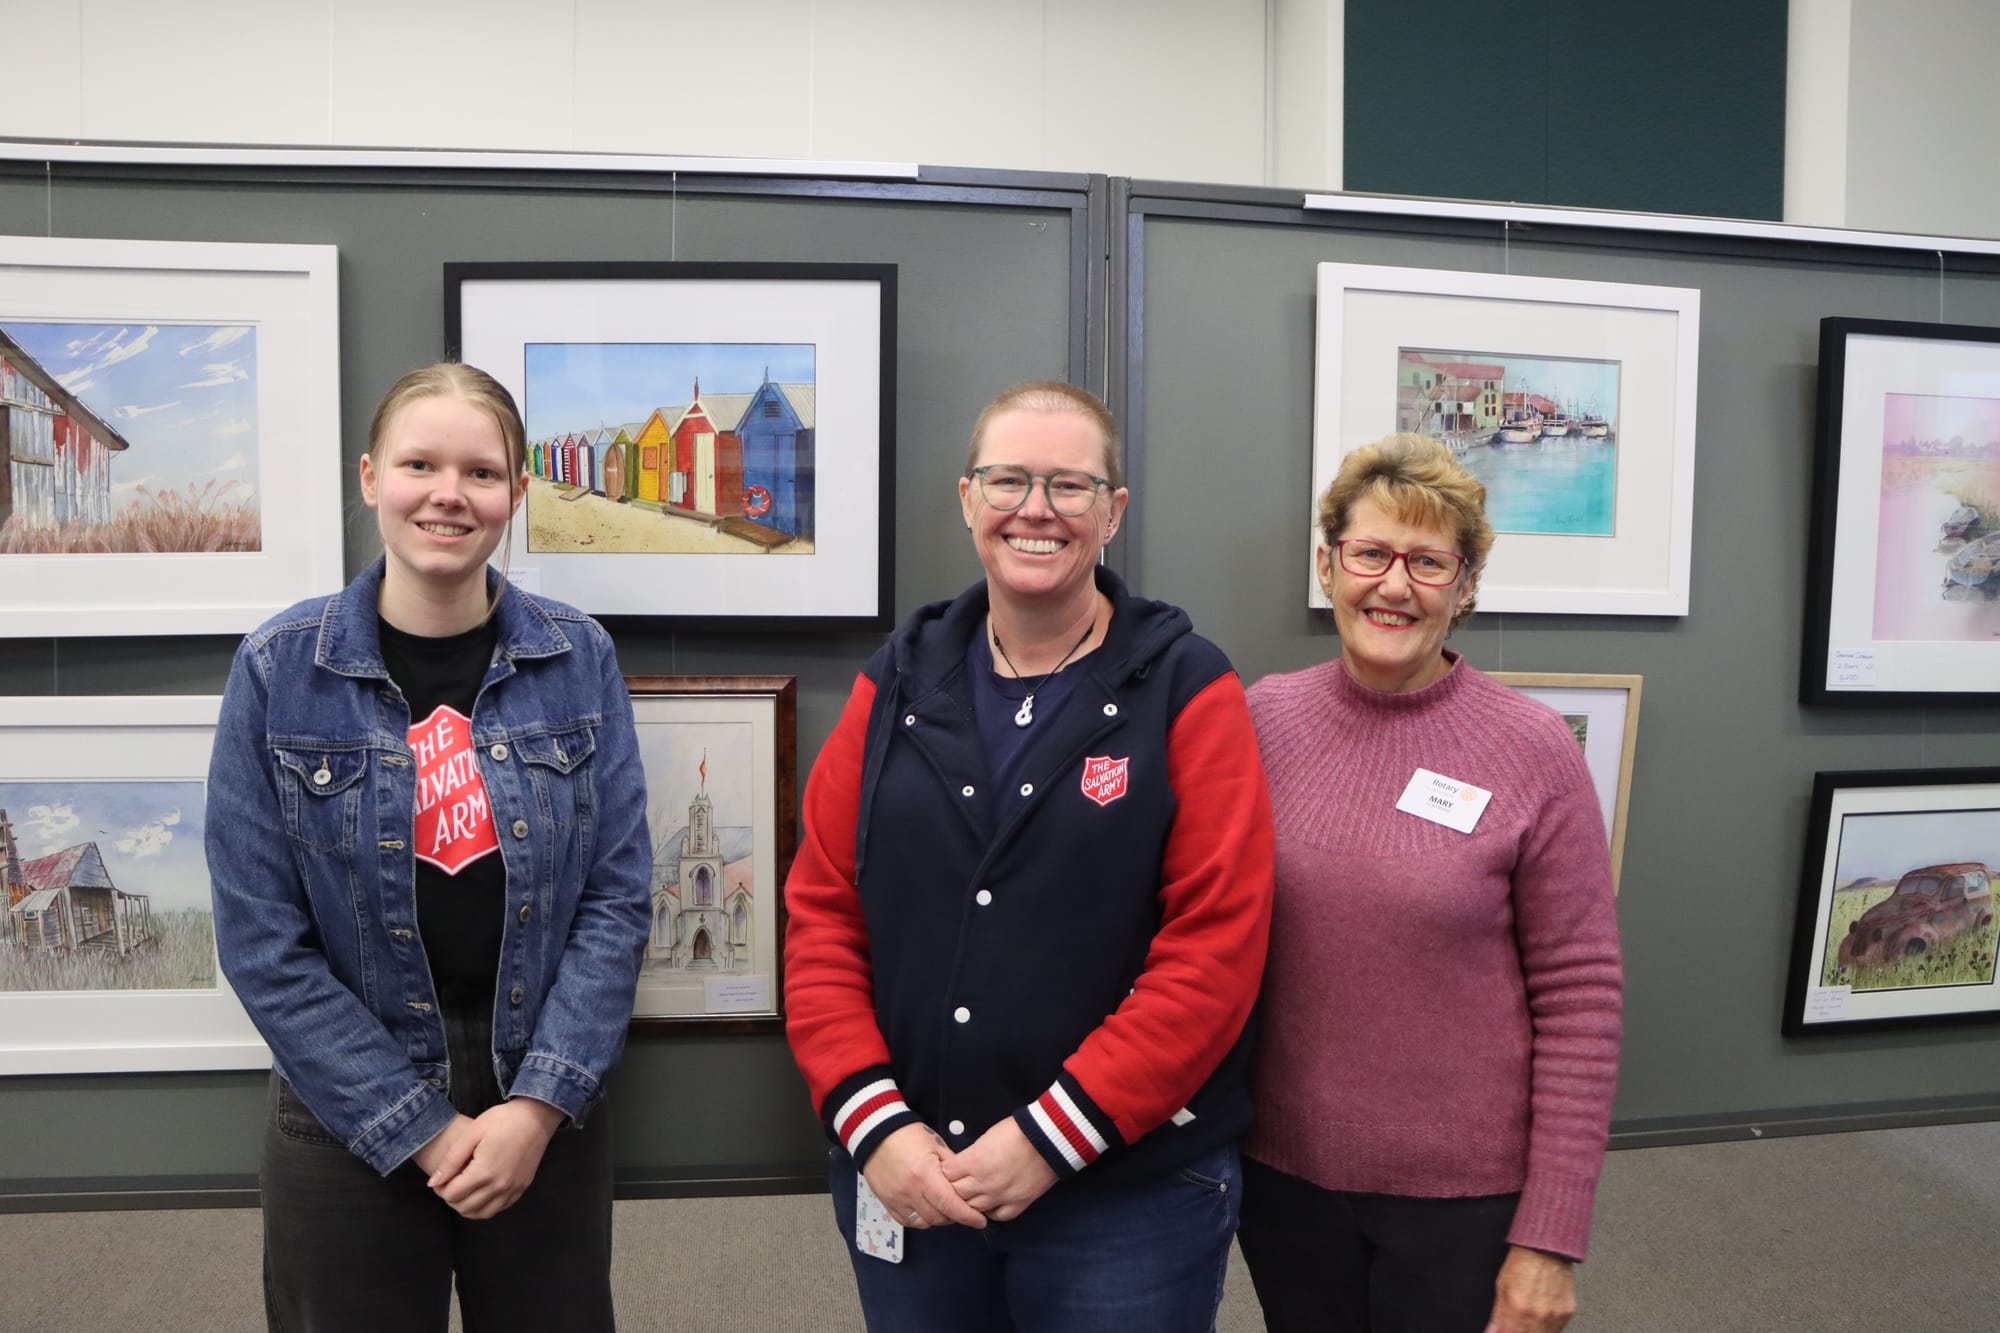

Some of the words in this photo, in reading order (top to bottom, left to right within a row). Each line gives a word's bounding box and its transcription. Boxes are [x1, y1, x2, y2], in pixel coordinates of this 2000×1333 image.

[1084, 762, 1124, 791] SALVATION
[1091, 760, 1110, 774] THE
[414, 747, 480, 815] LVATI
[1097, 775, 1123, 799] ARMY
[1432, 779, 1459, 794] Rotary
[1428, 795, 1454, 809] MARY
[431, 787, 489, 855] ARM
